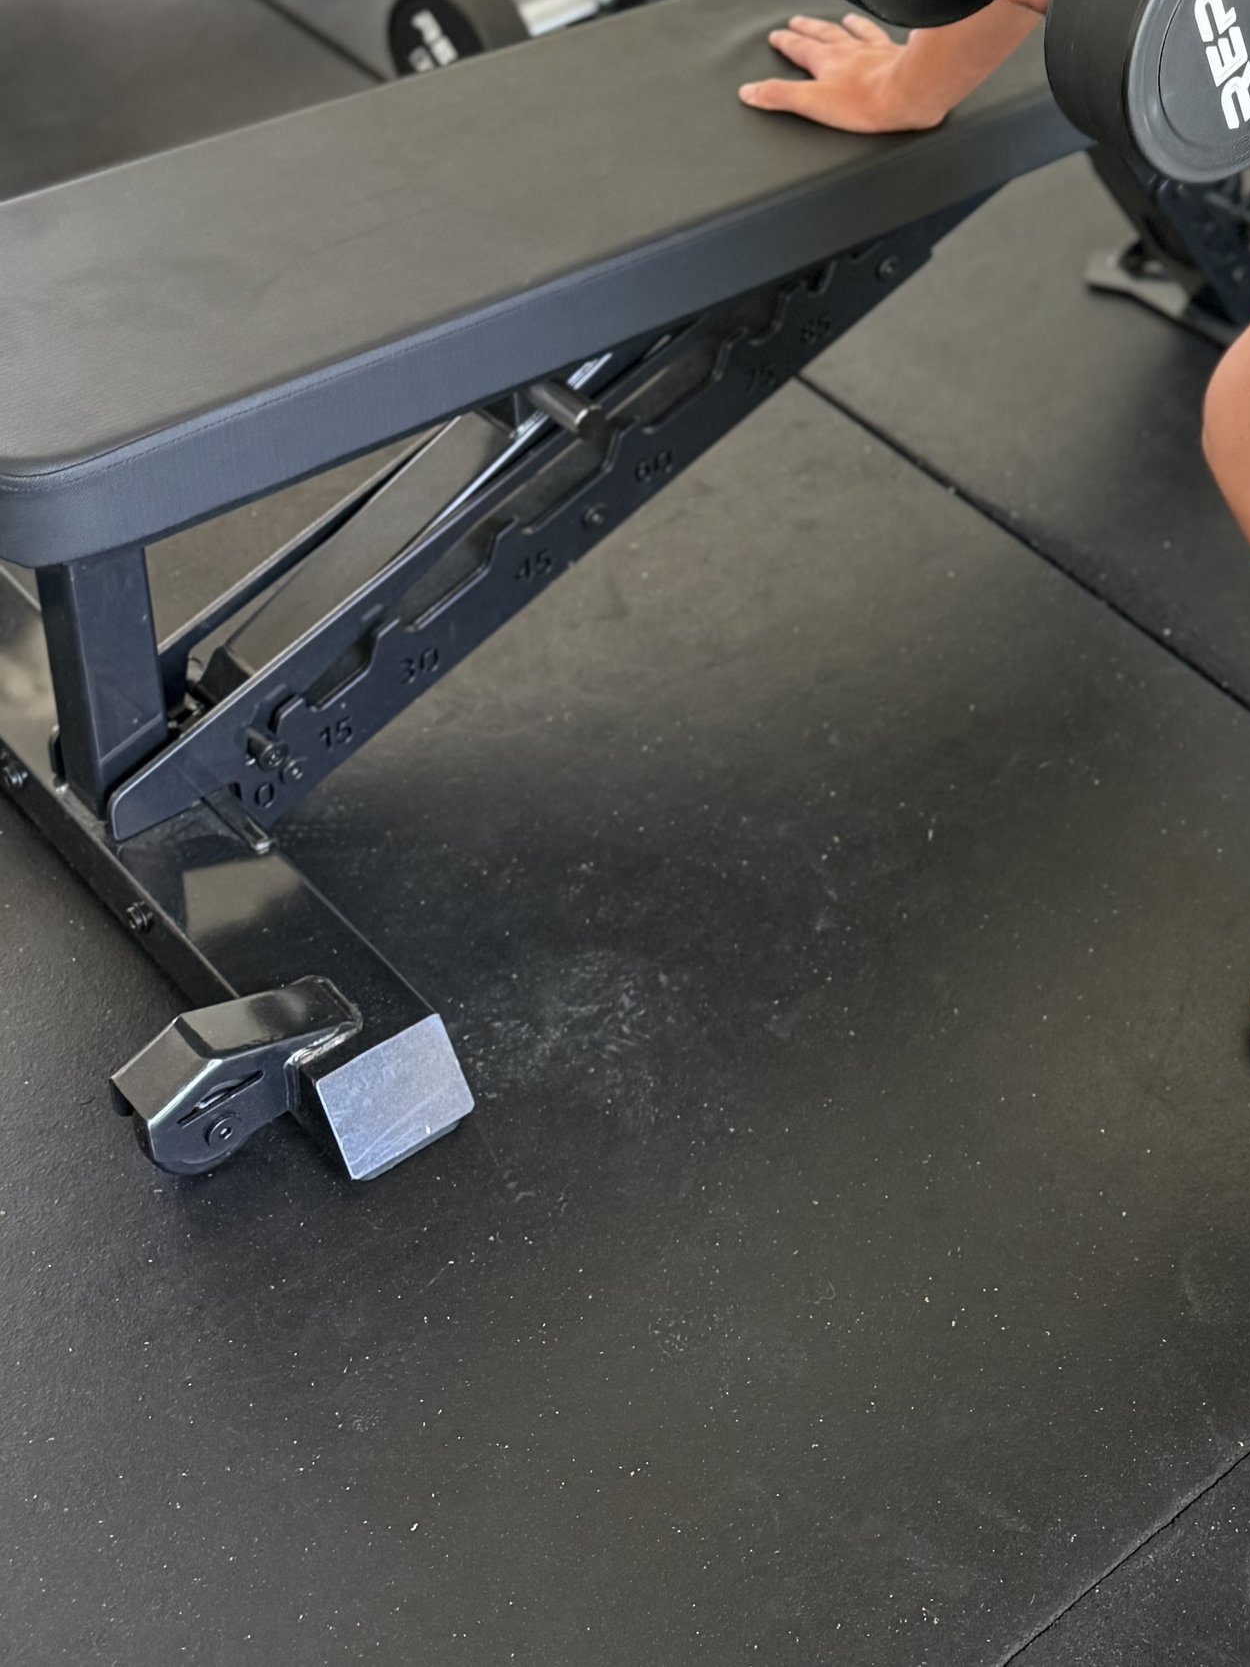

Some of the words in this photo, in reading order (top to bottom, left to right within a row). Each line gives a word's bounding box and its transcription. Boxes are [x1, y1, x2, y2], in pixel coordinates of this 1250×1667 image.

[514, 547, 553, 583] 45
[399, 647, 439, 685] 30
[320, 716, 354, 750] 15
